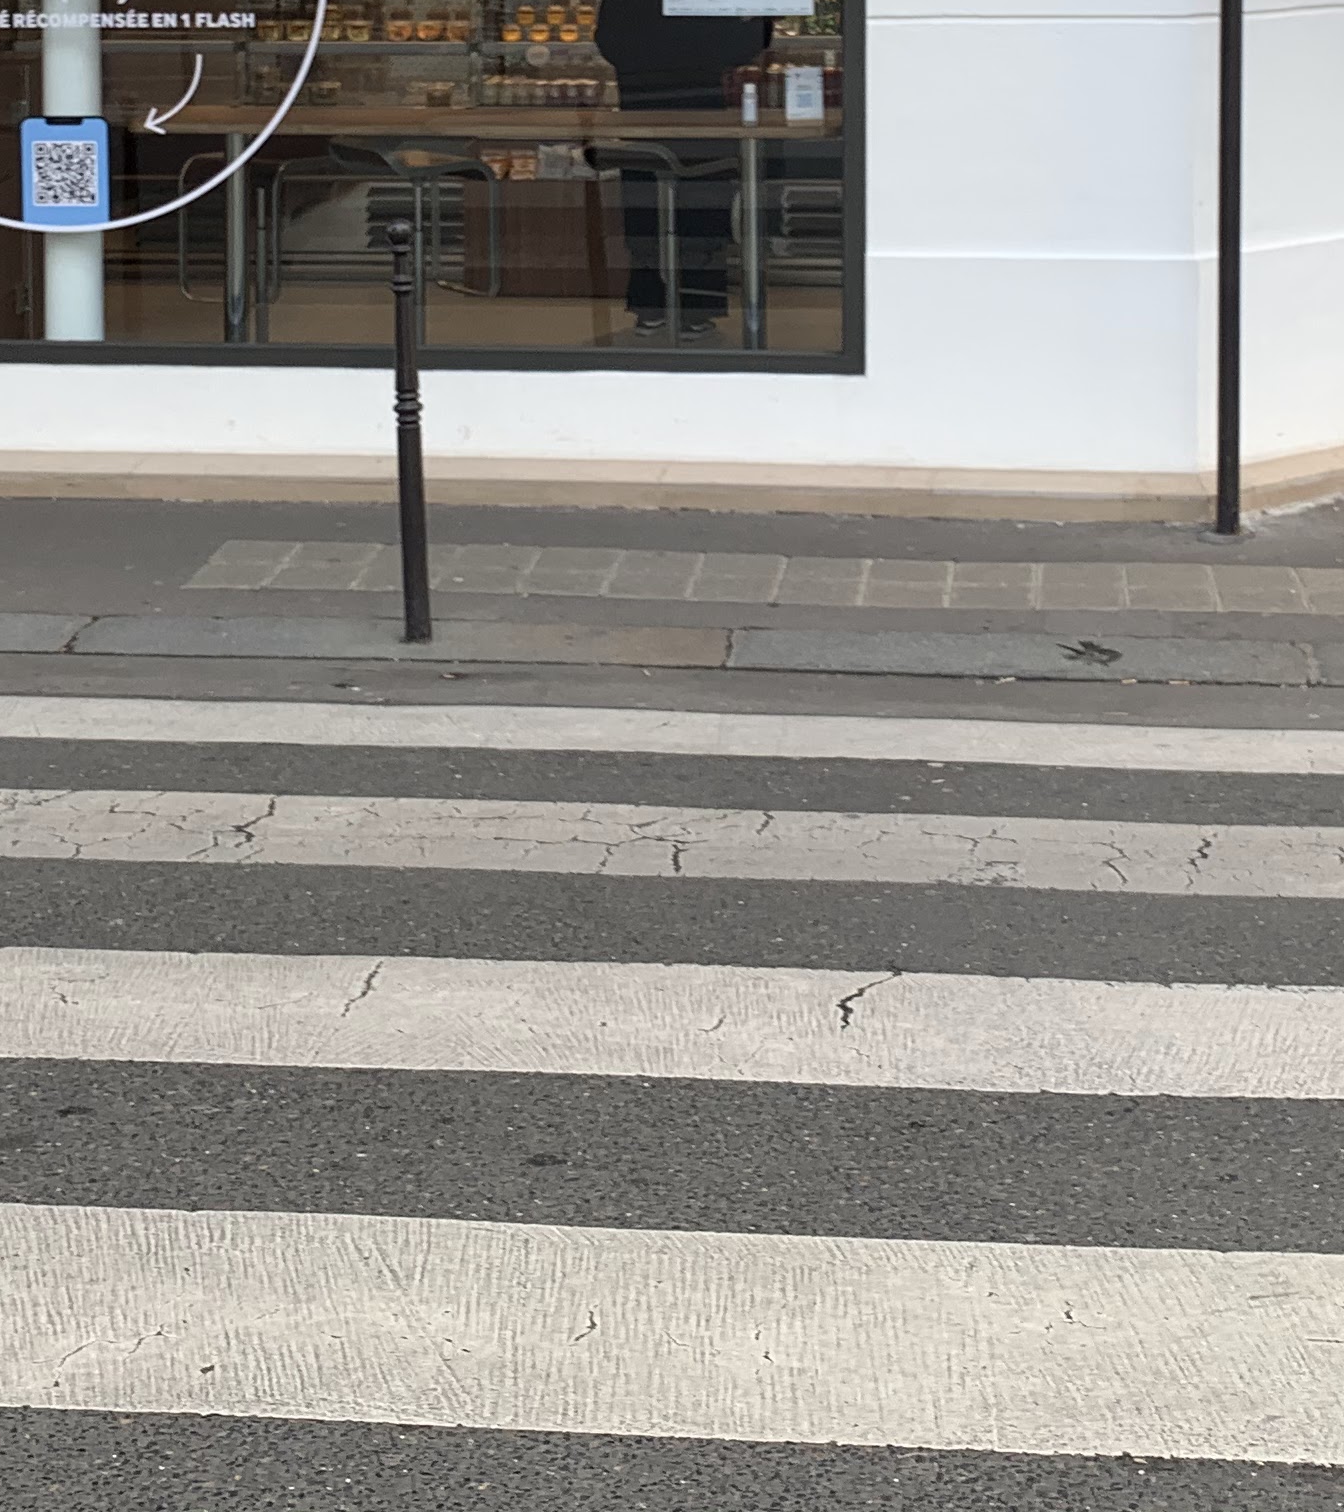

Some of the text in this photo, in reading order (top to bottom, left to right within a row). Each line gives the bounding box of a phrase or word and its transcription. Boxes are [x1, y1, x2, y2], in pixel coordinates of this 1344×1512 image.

[12, 9, 151, 29] RÉCOMPENSÉE
[152, 13, 178, 29] EN
[195, 13, 255, 29] FLASH
